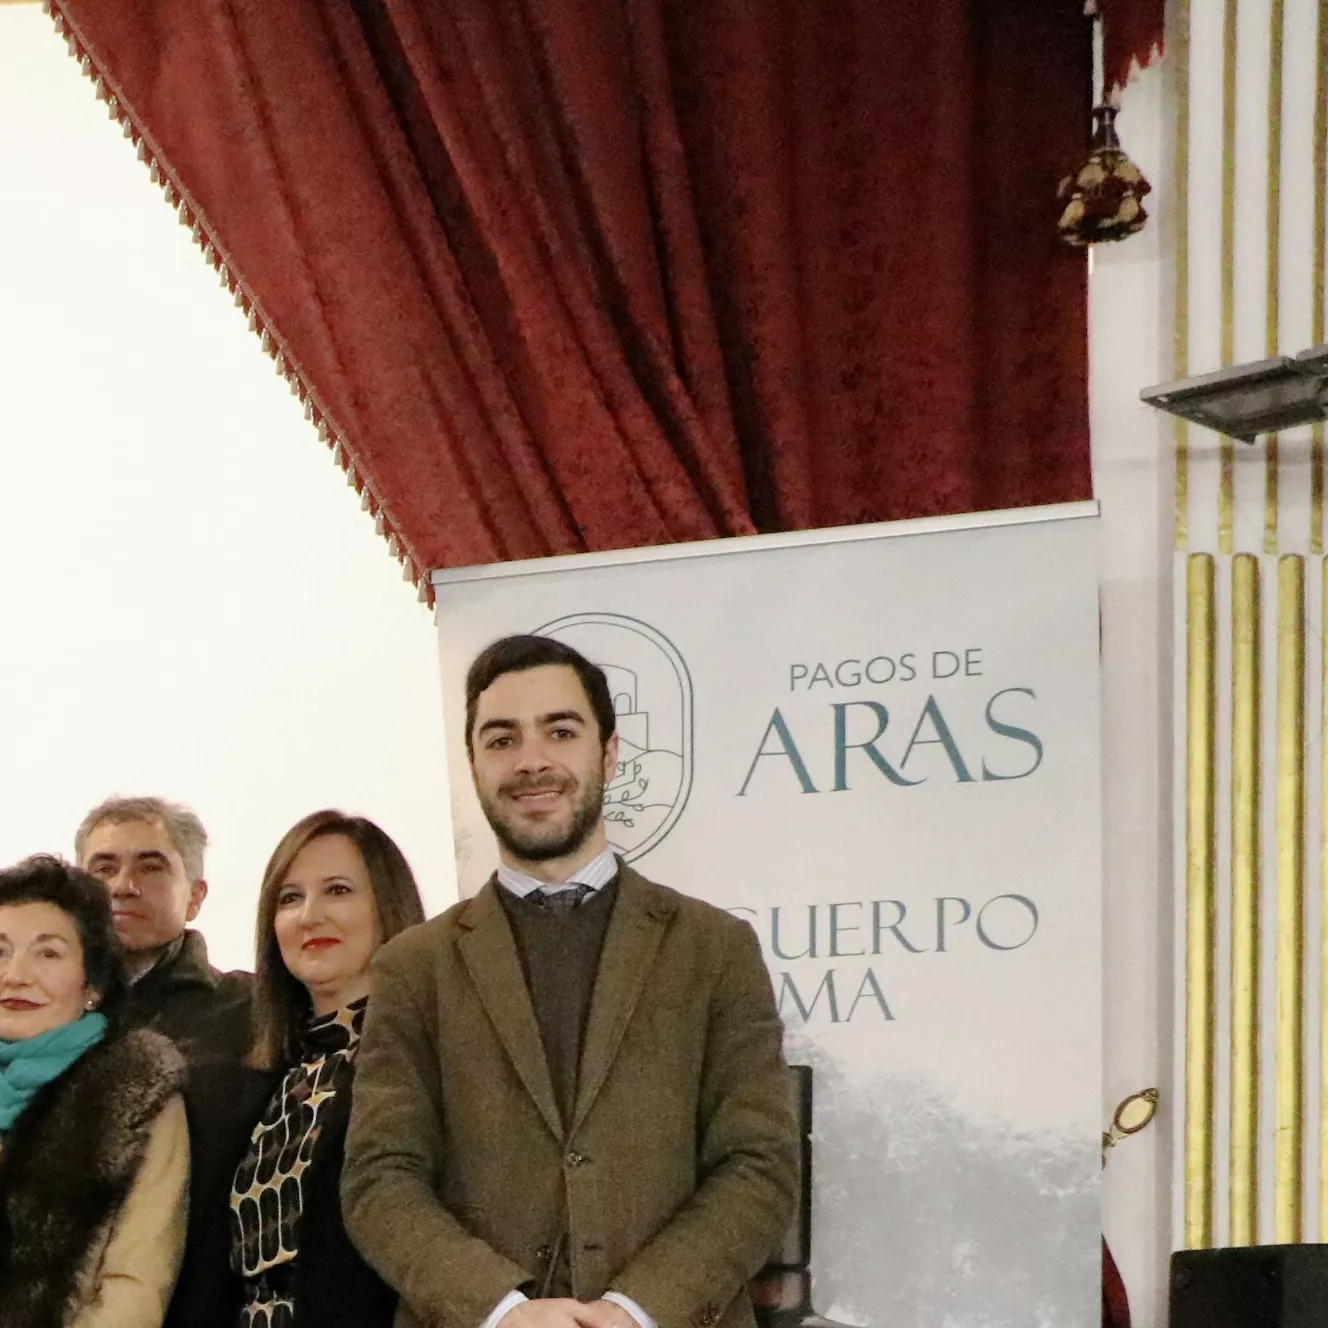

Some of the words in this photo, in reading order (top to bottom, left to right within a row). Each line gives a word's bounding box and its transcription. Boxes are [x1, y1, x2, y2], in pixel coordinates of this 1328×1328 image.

[789, 653, 917, 692] PAGOS
[931, 648, 985, 680] DE
[735, 687, 1044, 797] ARAS
[723, 893, 1040, 961] UERPO
[777, 966, 897, 1024] MA
